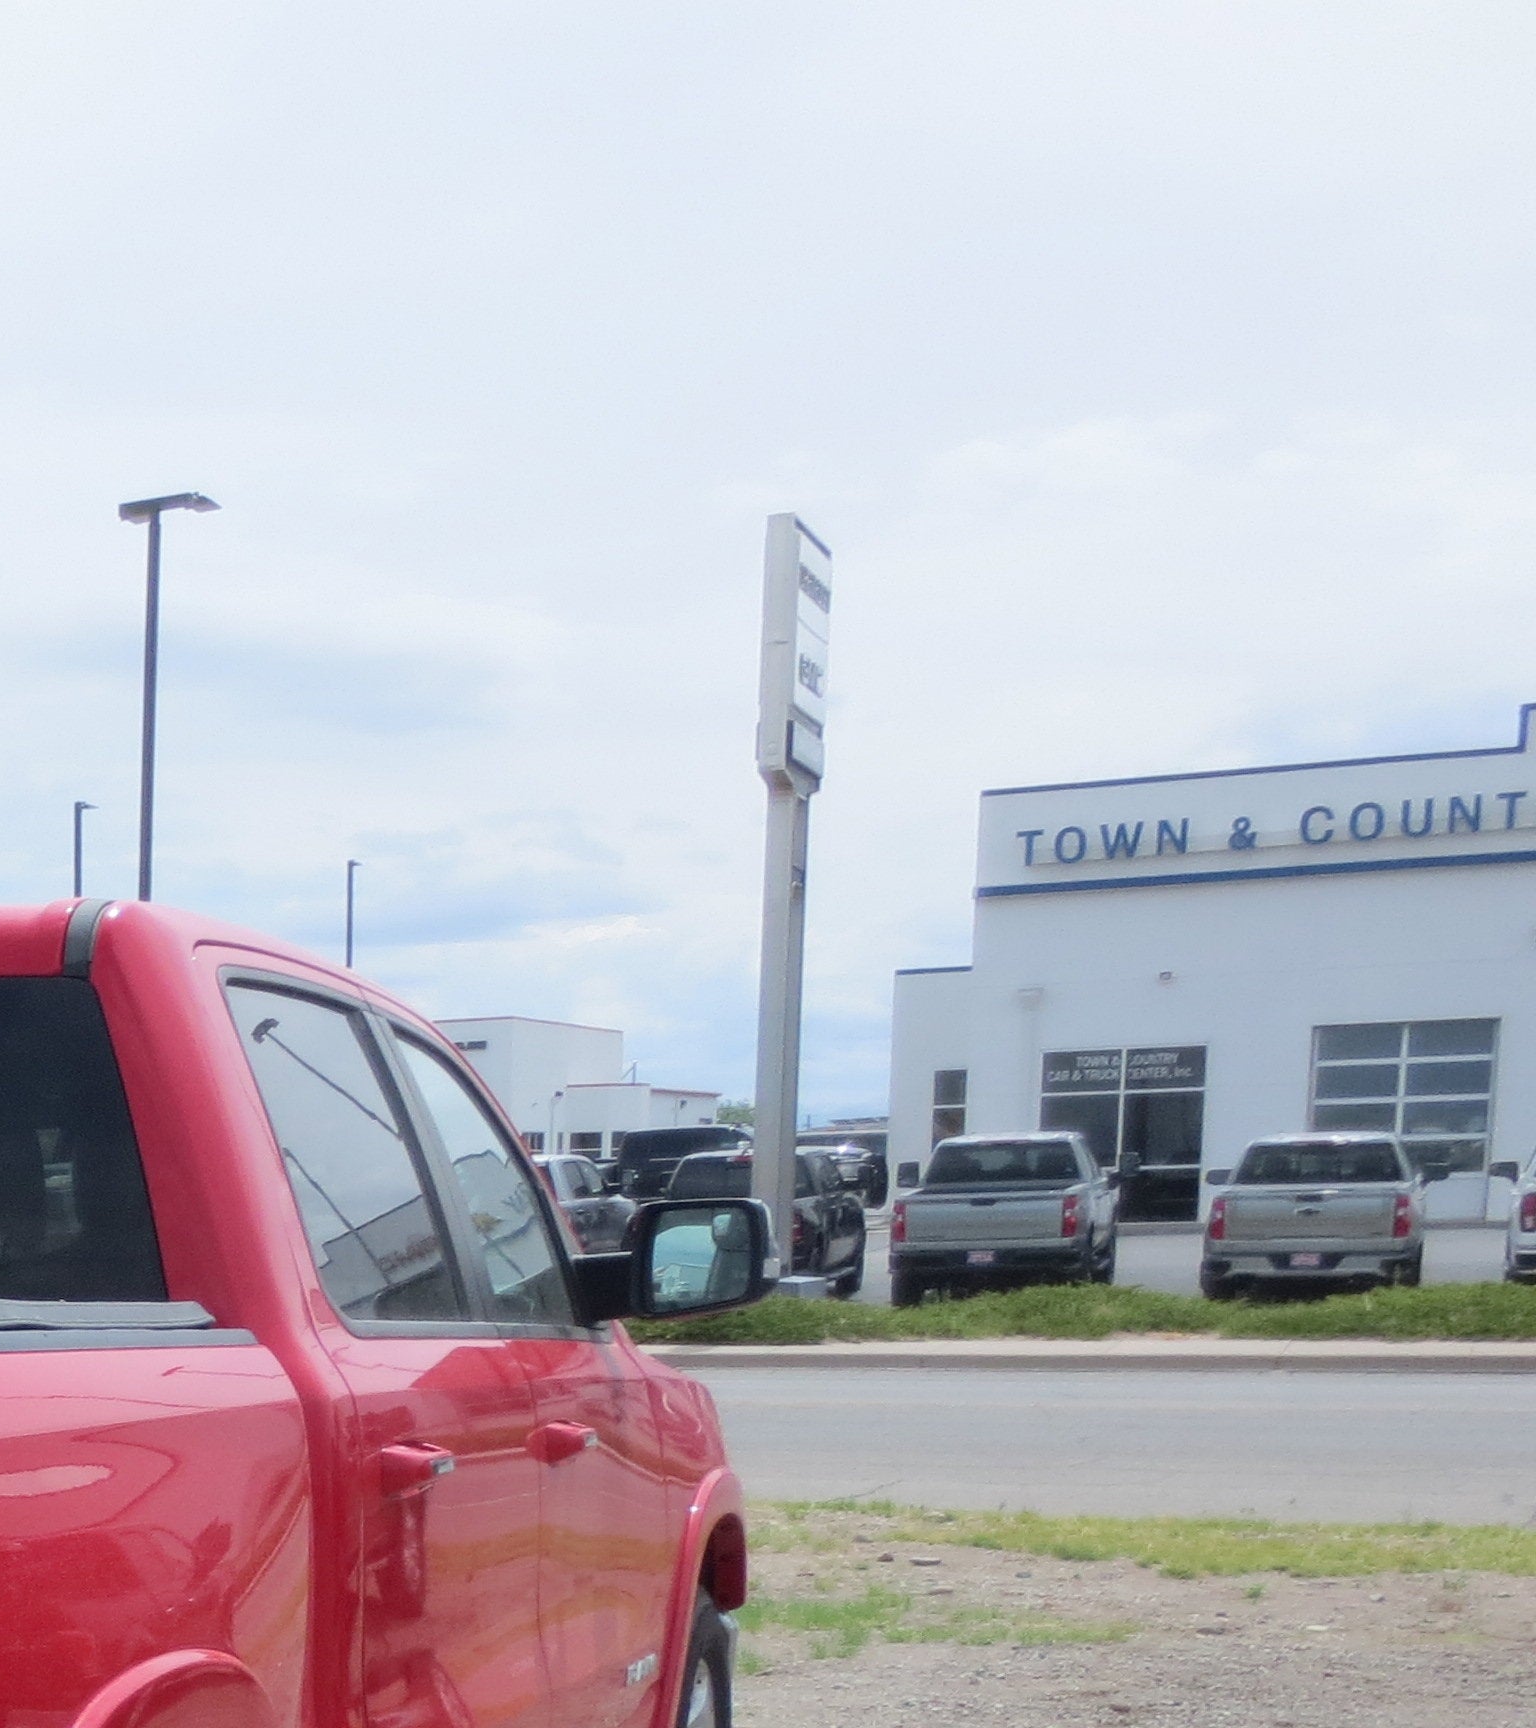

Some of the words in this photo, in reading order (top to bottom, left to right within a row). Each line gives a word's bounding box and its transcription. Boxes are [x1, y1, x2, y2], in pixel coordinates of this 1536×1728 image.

[1016, 818, 1190, 867] TOWN
[1228, 816, 1258, 851] &
[1298, 791, 1528, 846] COUNT
